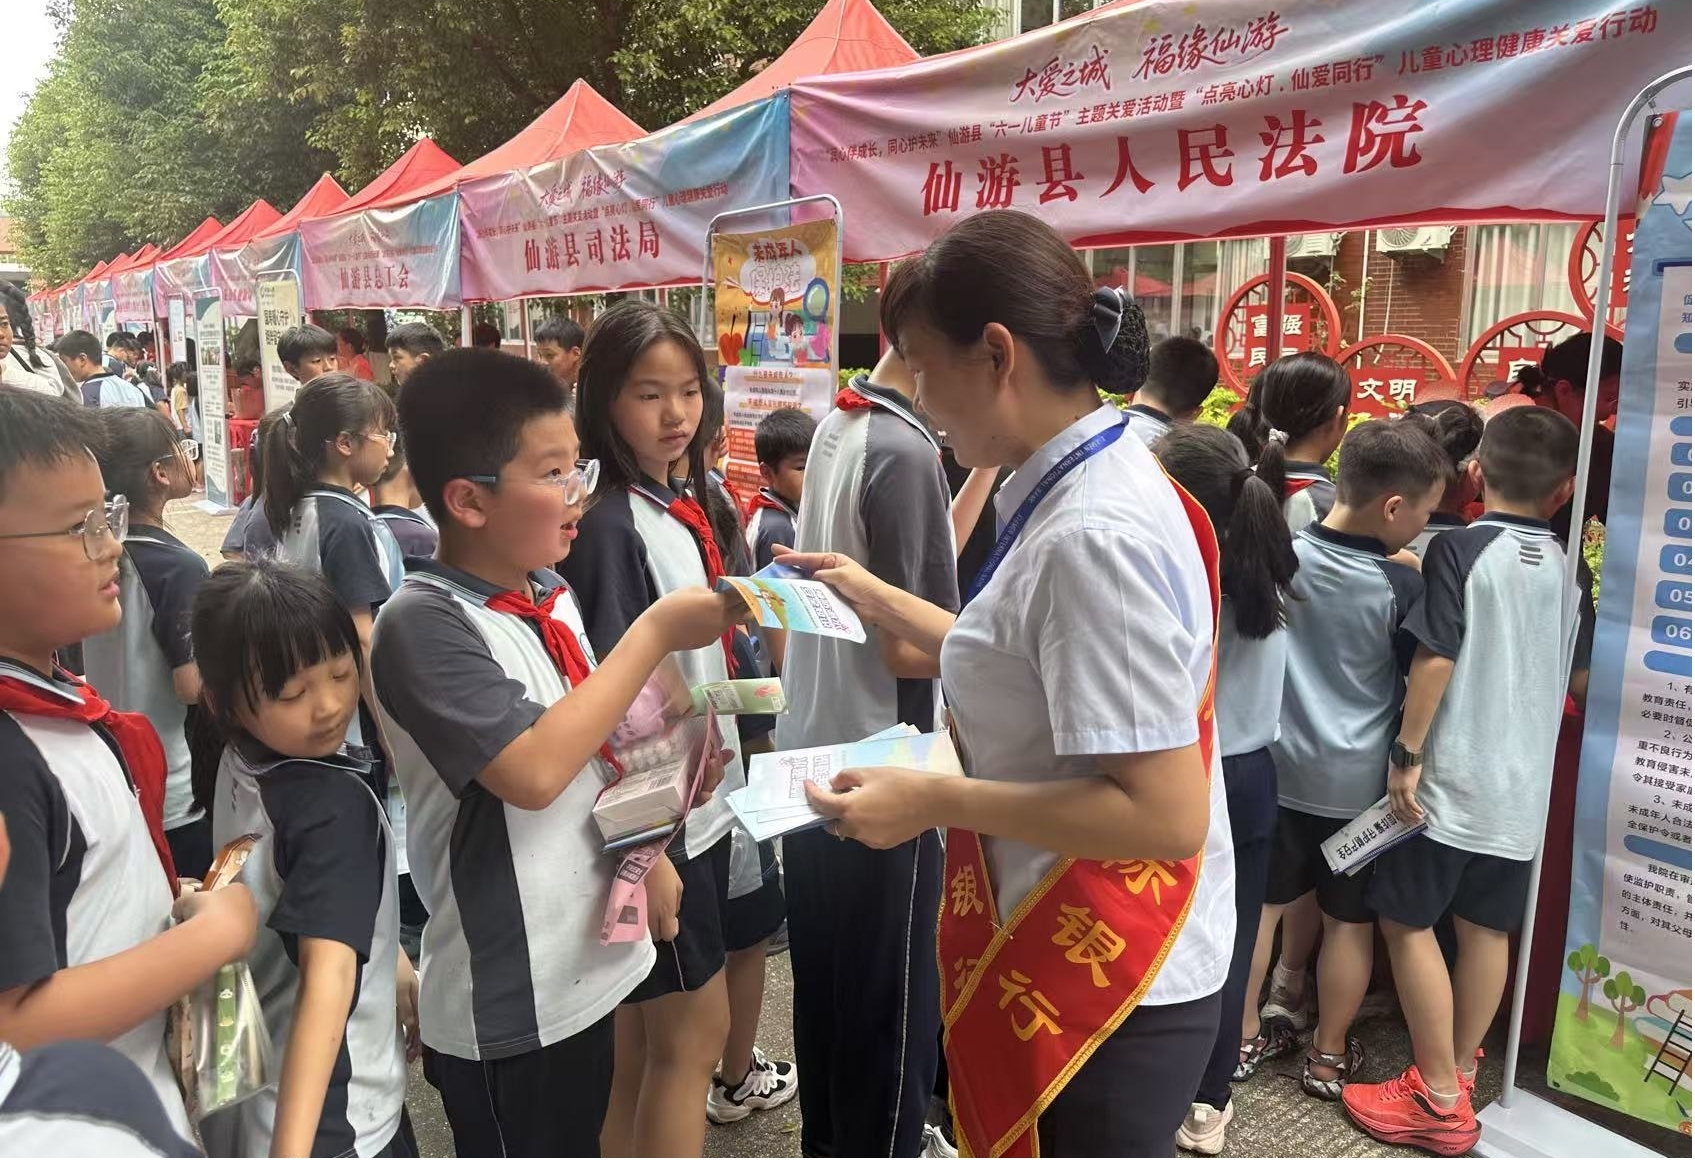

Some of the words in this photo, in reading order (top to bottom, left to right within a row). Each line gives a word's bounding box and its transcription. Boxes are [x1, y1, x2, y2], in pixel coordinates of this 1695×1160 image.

[1009, 45, 1111, 102] 大爱之城
[1131, 10, 1290, 80] 福缘仙游
[921, 94, 1428, 216] 仙游县人民法院
[524, 221, 660, 274] 仙游县司法局
[1357, 378, 1418, 402] 文明
[1666, 625, 1691, 640] 06
[1638, 740, 1692, 761] 重不良行为
[1634, 756, 1692, 778] 教育侵害未
[1336, 826, 1378, 860] 守护财产安全
[1648, 863, 1692, 886] 我院在审
